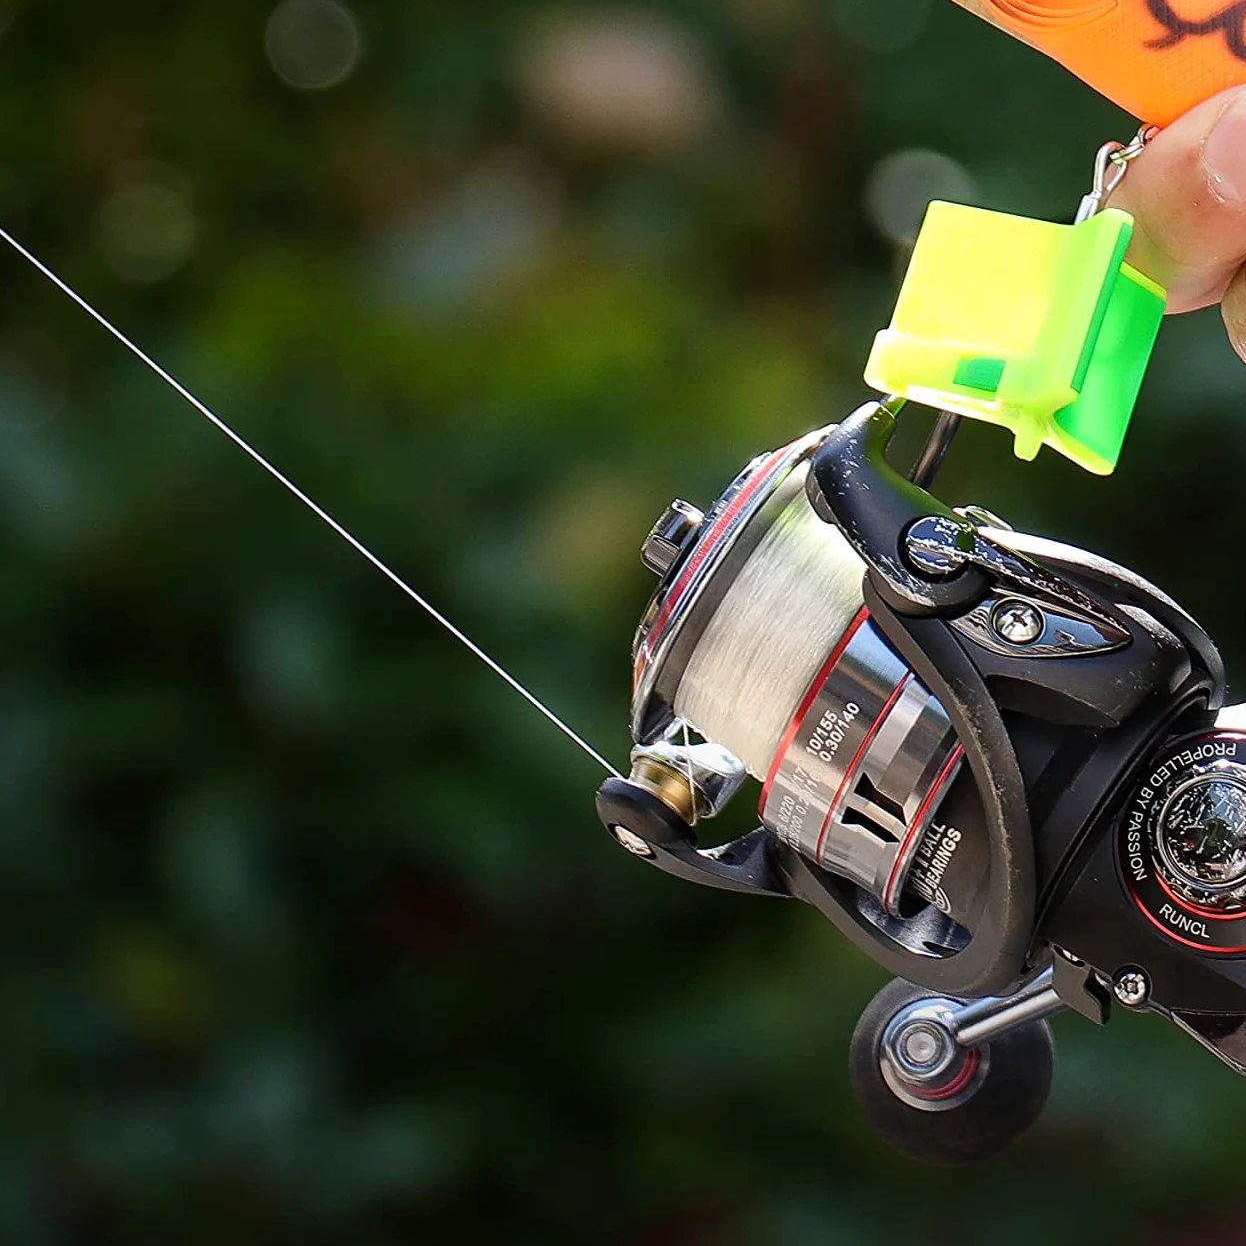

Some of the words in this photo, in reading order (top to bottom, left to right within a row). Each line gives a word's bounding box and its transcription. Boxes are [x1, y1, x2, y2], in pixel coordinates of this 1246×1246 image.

[805, 709, 838, 757] 10/155
[819, 702, 861, 762] 0.30/140
[1150, 742, 1238, 788] PROPELLED
[1135, 787, 1154, 810] BY
[920, 823, 947, 858] BALL
[926, 827, 962, 889] BEARINGS
[1127, 810, 1148, 882] PASSION
[1159, 903, 1211, 939] RUNCL
